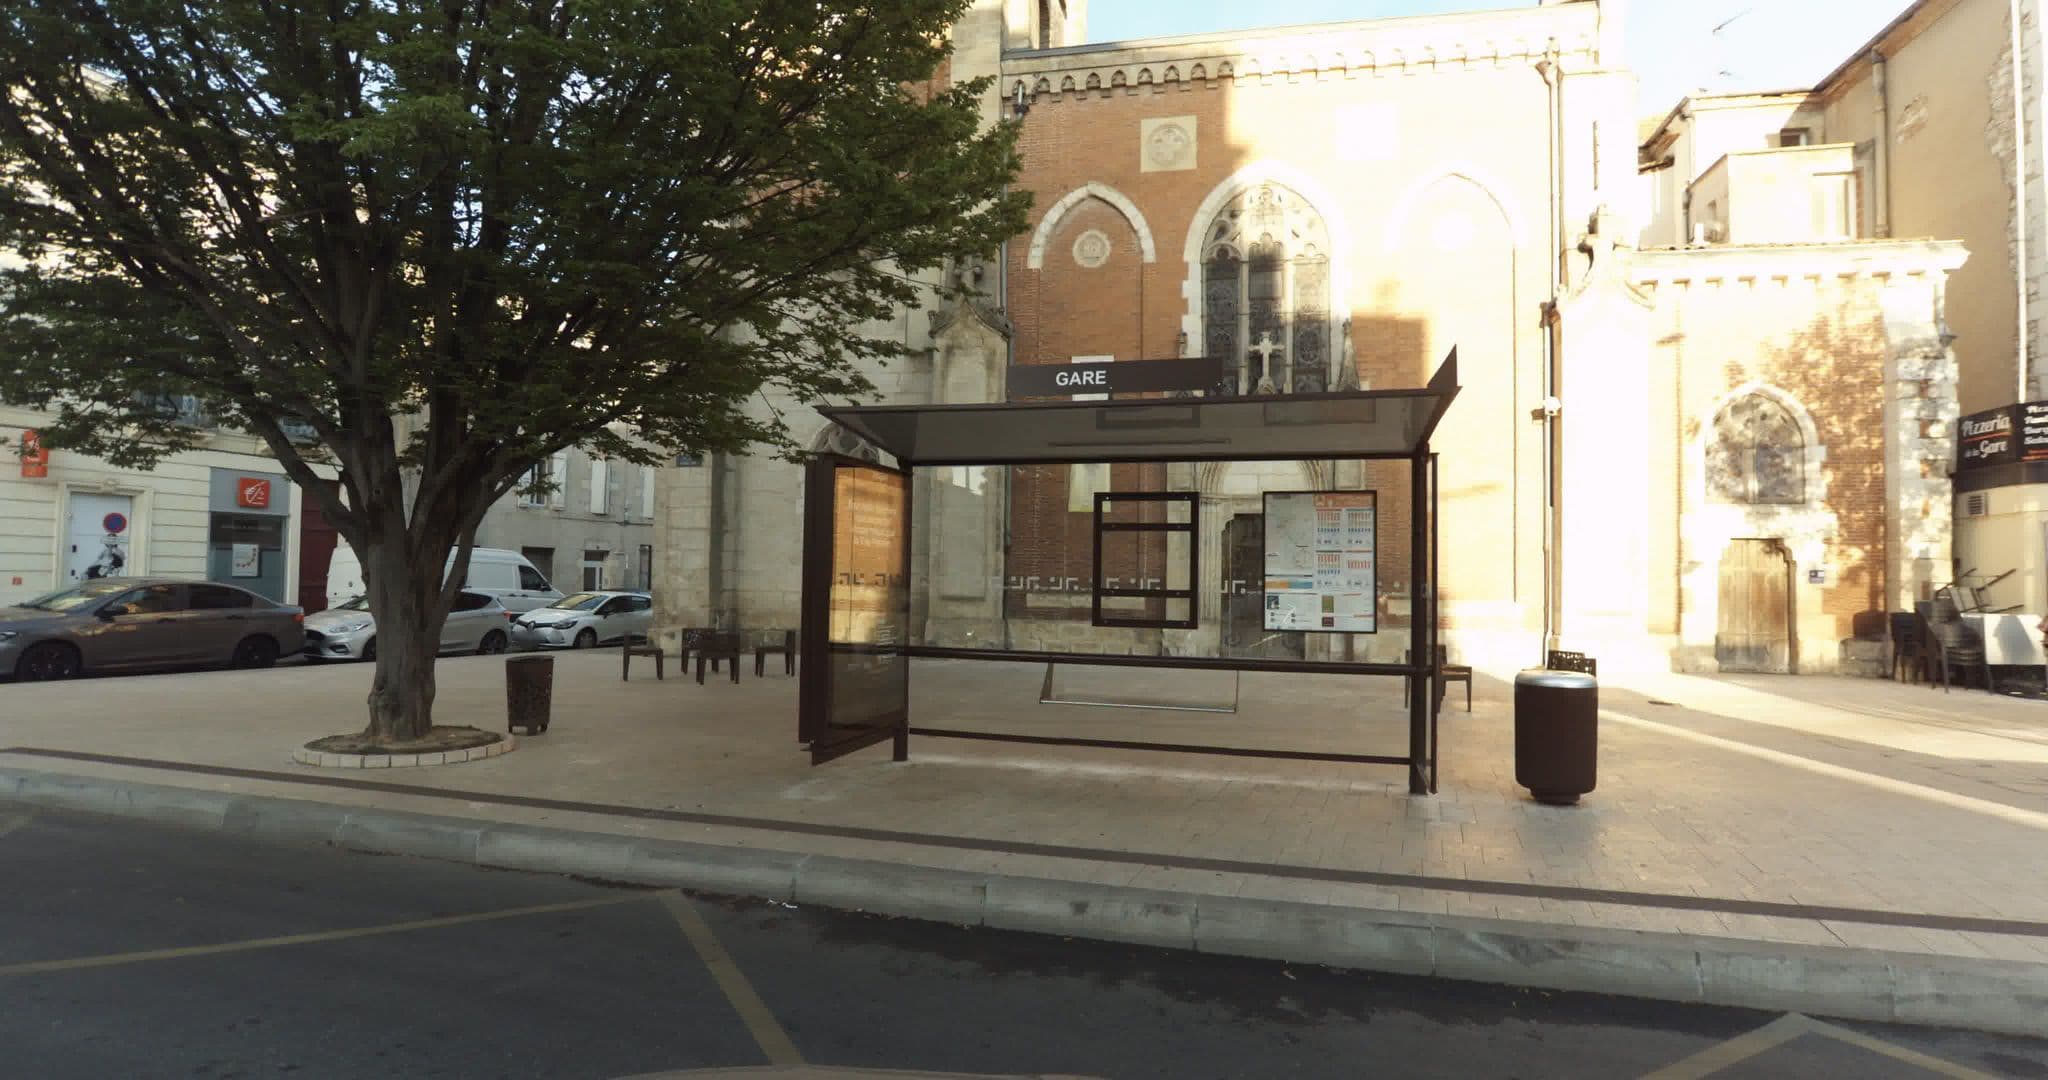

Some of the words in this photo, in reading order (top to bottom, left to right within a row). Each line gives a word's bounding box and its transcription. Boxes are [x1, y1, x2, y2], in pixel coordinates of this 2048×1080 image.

[1055, 370, 1107, 387] GARE
[1961, 415, 2010, 437] Pizzeria
[1980, 440, 2008, 458] Gare
